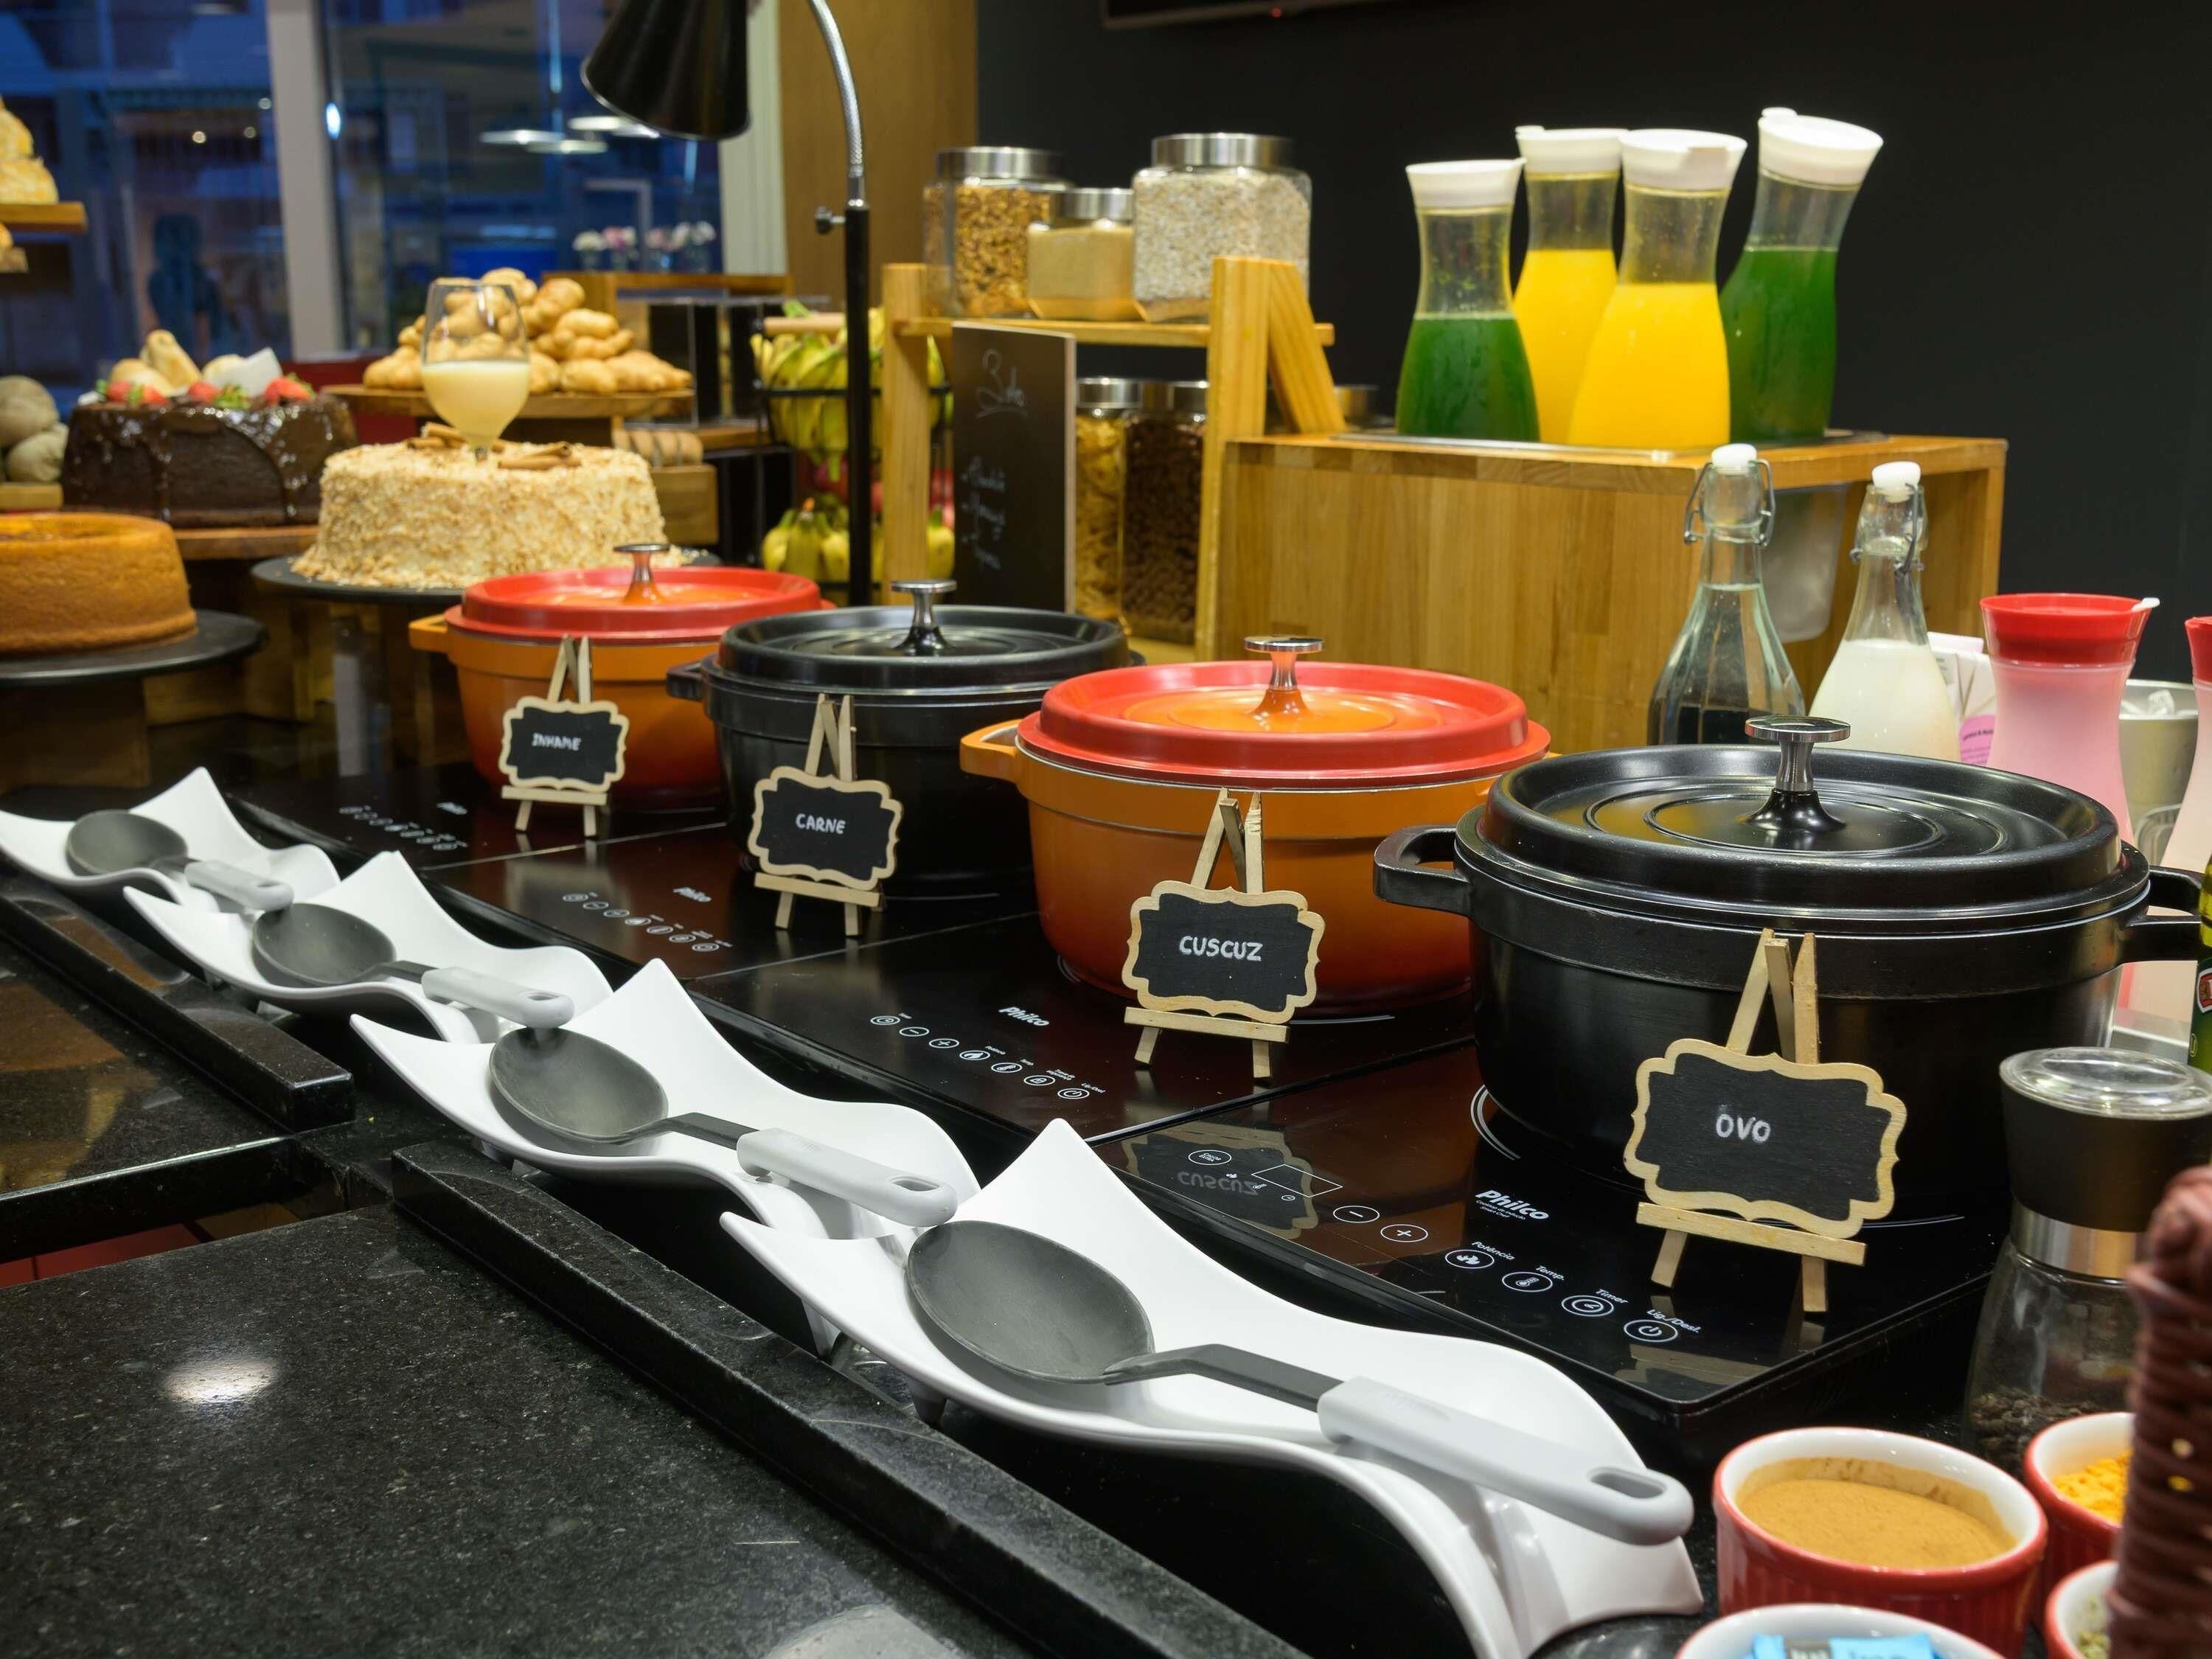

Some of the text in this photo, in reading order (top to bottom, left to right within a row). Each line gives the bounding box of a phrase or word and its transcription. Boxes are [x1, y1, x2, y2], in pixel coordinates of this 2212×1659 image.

[532, 732, 582, 751] INHAME
[796, 813, 846, 835] CARNE
[1179, 935, 1263, 961] CUSCUZ
[998, 1006, 1050, 1026] Philco
[1475, 1189, 1549, 1220] Philco
[1472, 1241, 1515, 1260] Potência
[1596, 1288, 1629, 1304] Timer
